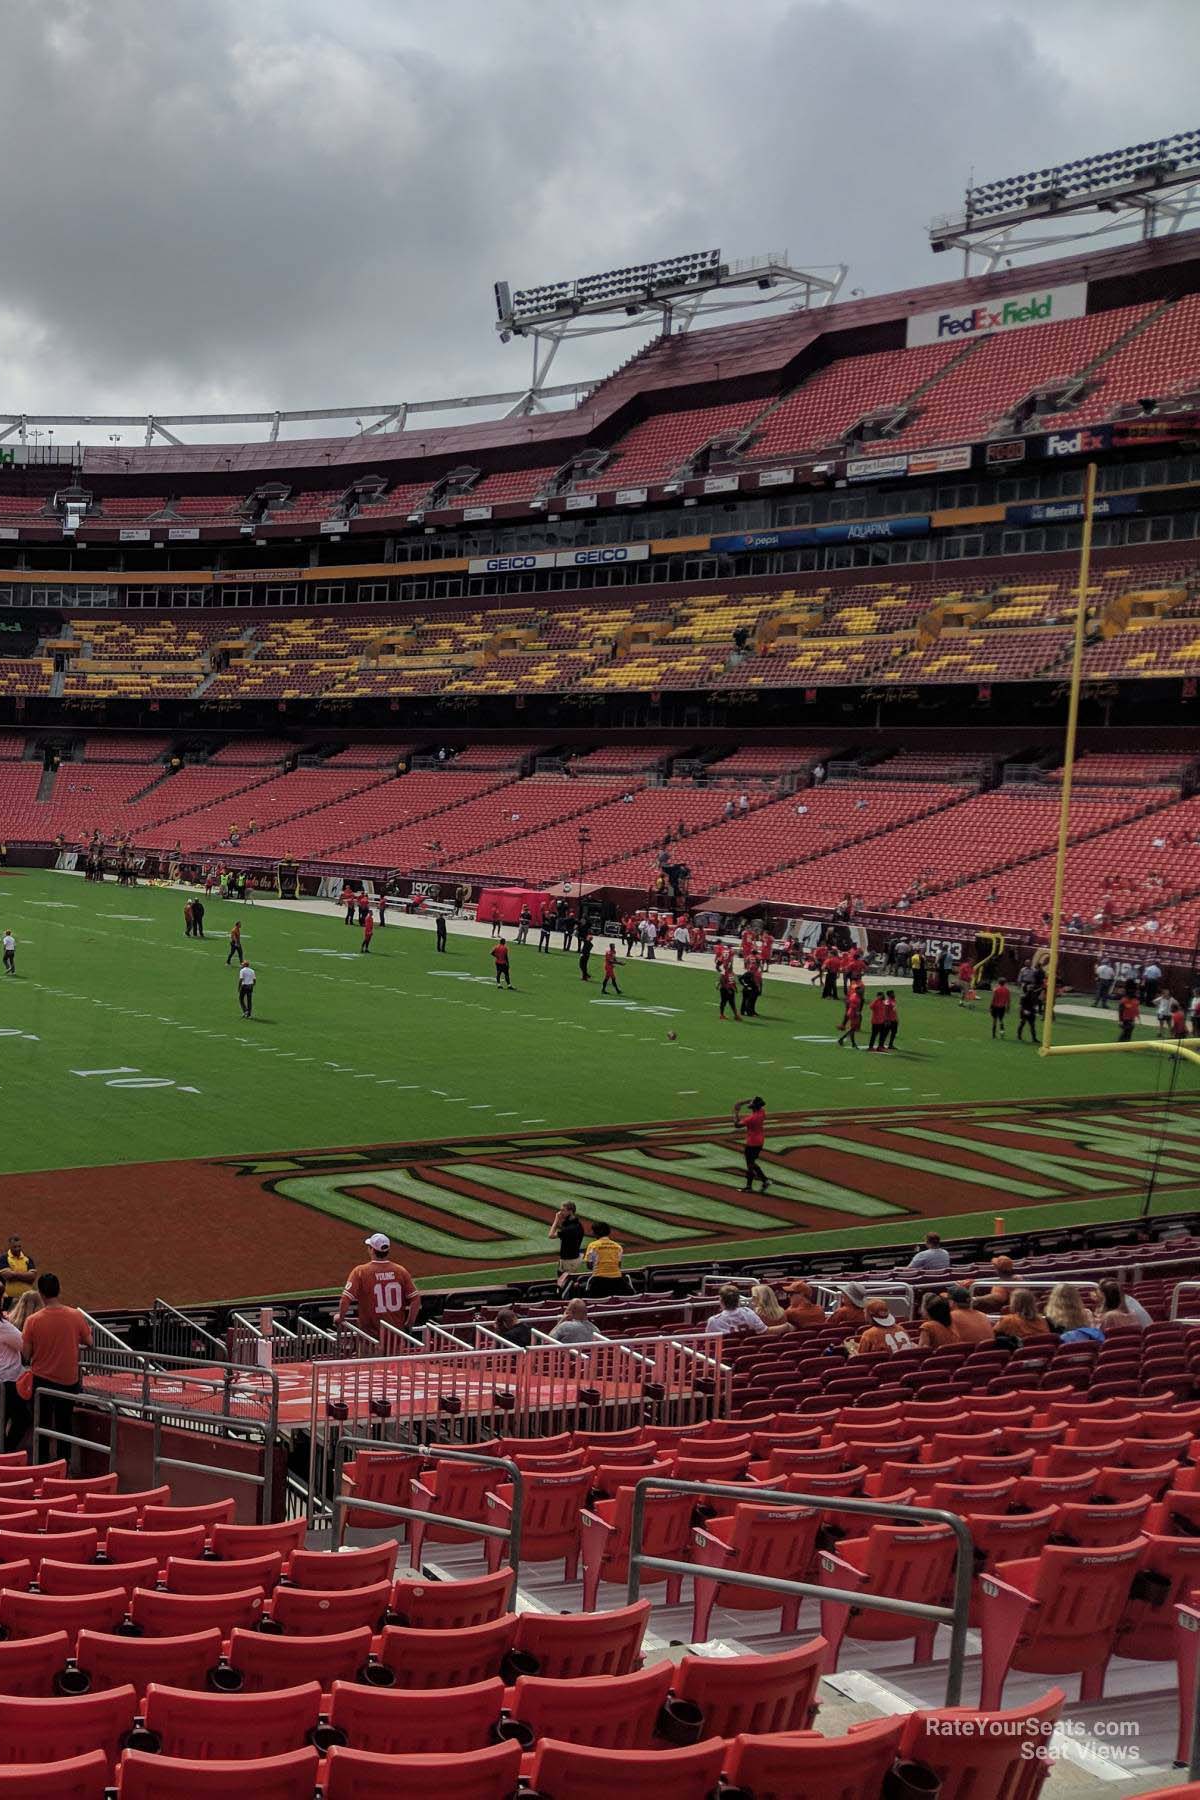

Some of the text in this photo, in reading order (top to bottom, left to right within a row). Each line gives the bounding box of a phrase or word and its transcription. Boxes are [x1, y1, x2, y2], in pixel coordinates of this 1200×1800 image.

[937, 295, 1053, 338] FedExField
[1046, 431, 1104, 456] FedEx
[1081, 501, 1110, 515] Lnch
[847, 521, 891, 540] AQUAFINA
[754, 536, 779, 549] pepsi
[486, 555, 537, 571] GEICO
[574, 548, 628, 564] GEICO
[374, 1271, 396, 1281] YOUNG
[373, 1281, 403, 1314] 10
